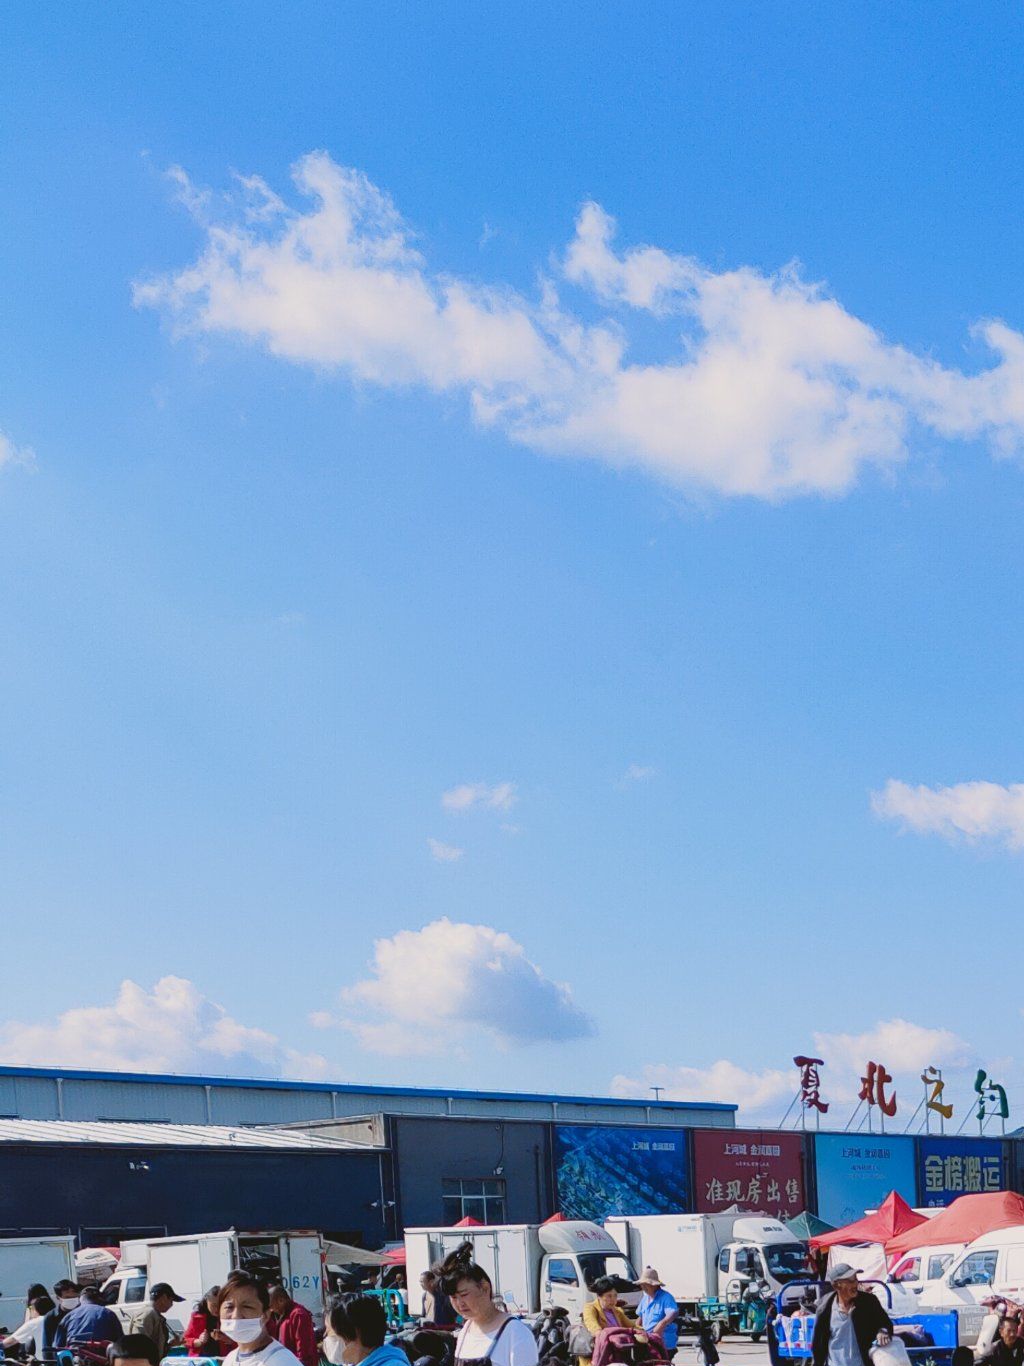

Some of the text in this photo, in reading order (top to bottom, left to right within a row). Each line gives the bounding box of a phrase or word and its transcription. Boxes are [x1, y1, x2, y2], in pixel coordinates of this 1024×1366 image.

[925, 1155, 1000, 1192] 金榜搬运
[705, 1177, 800, 1205] 准现房出售
